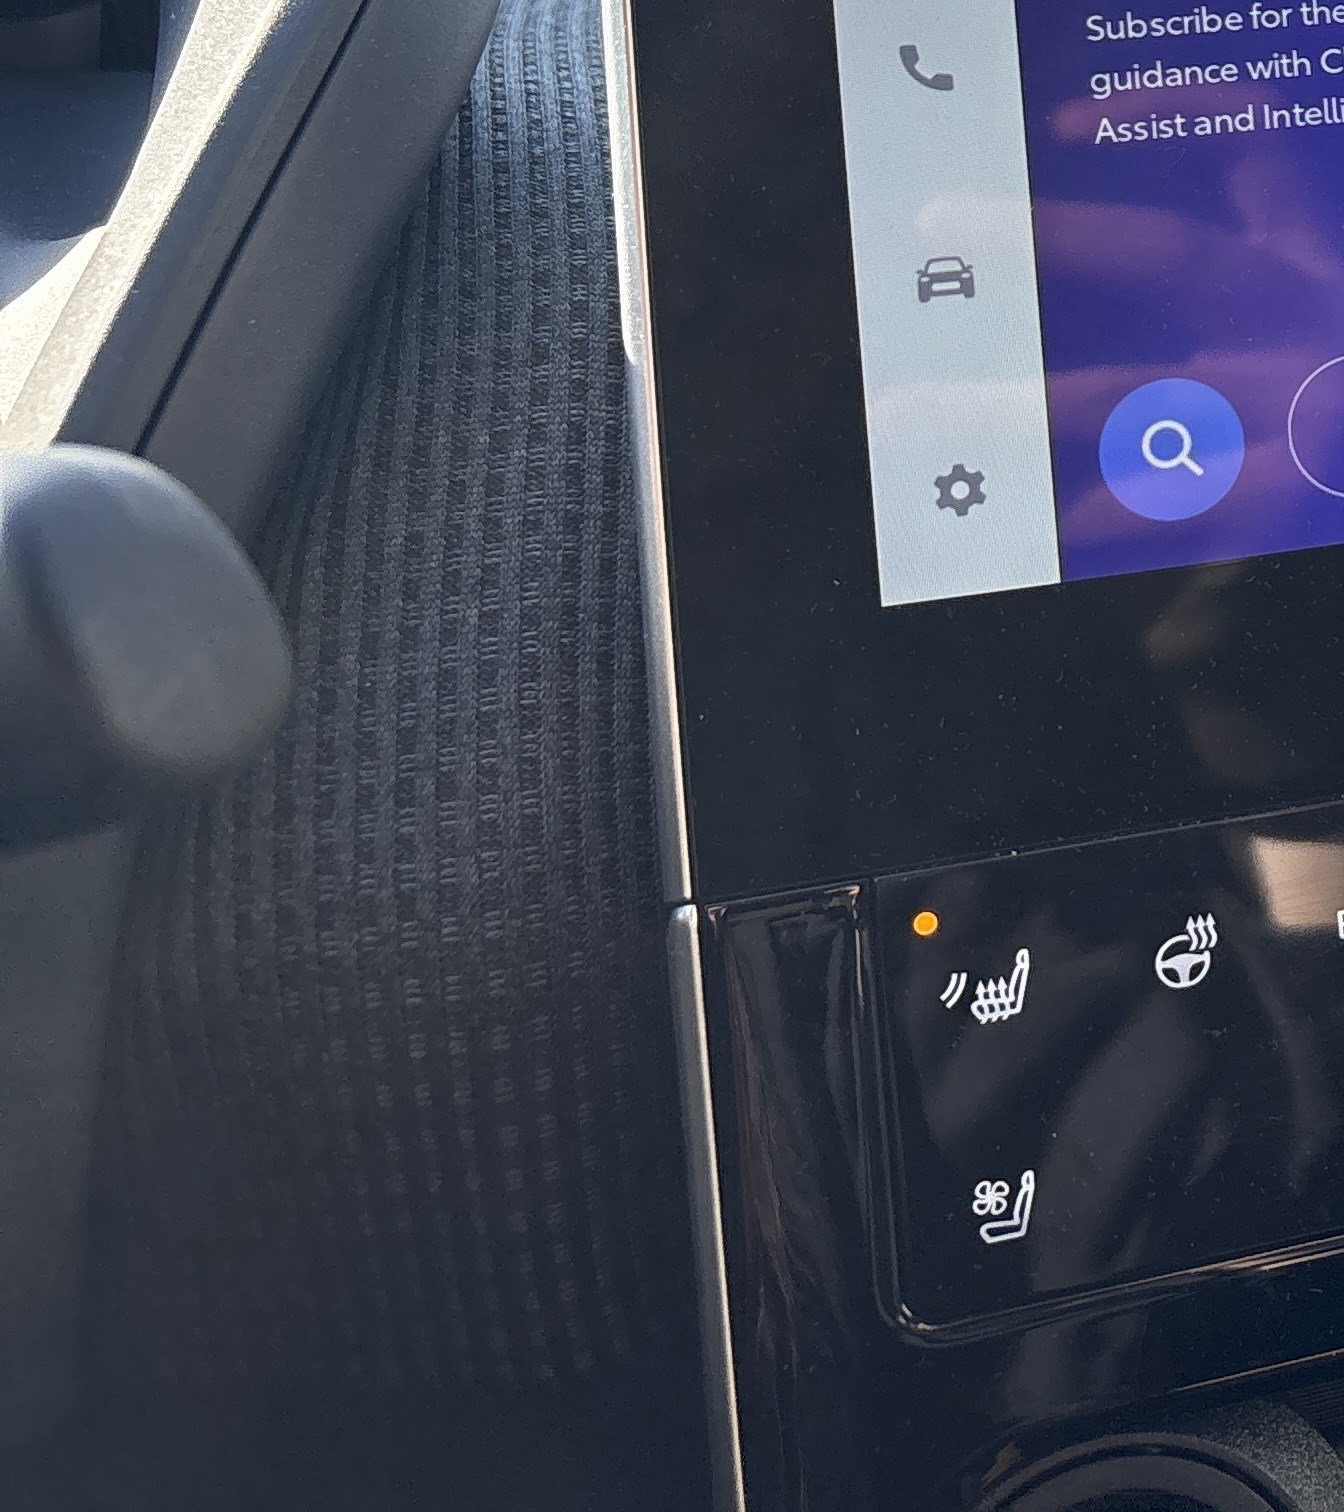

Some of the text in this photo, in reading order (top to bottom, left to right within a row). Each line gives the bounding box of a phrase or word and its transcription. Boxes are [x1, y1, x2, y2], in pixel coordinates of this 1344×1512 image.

[1085, 4, 1244, 42] Subscribe
[1250, 1, 1294, 30] for
[1089, 58, 1239, 101] guidance
[1246, 50, 1313, 82] with
[1094, 111, 1188, 146] Assist
[1193, 106, 1256, 136] and
